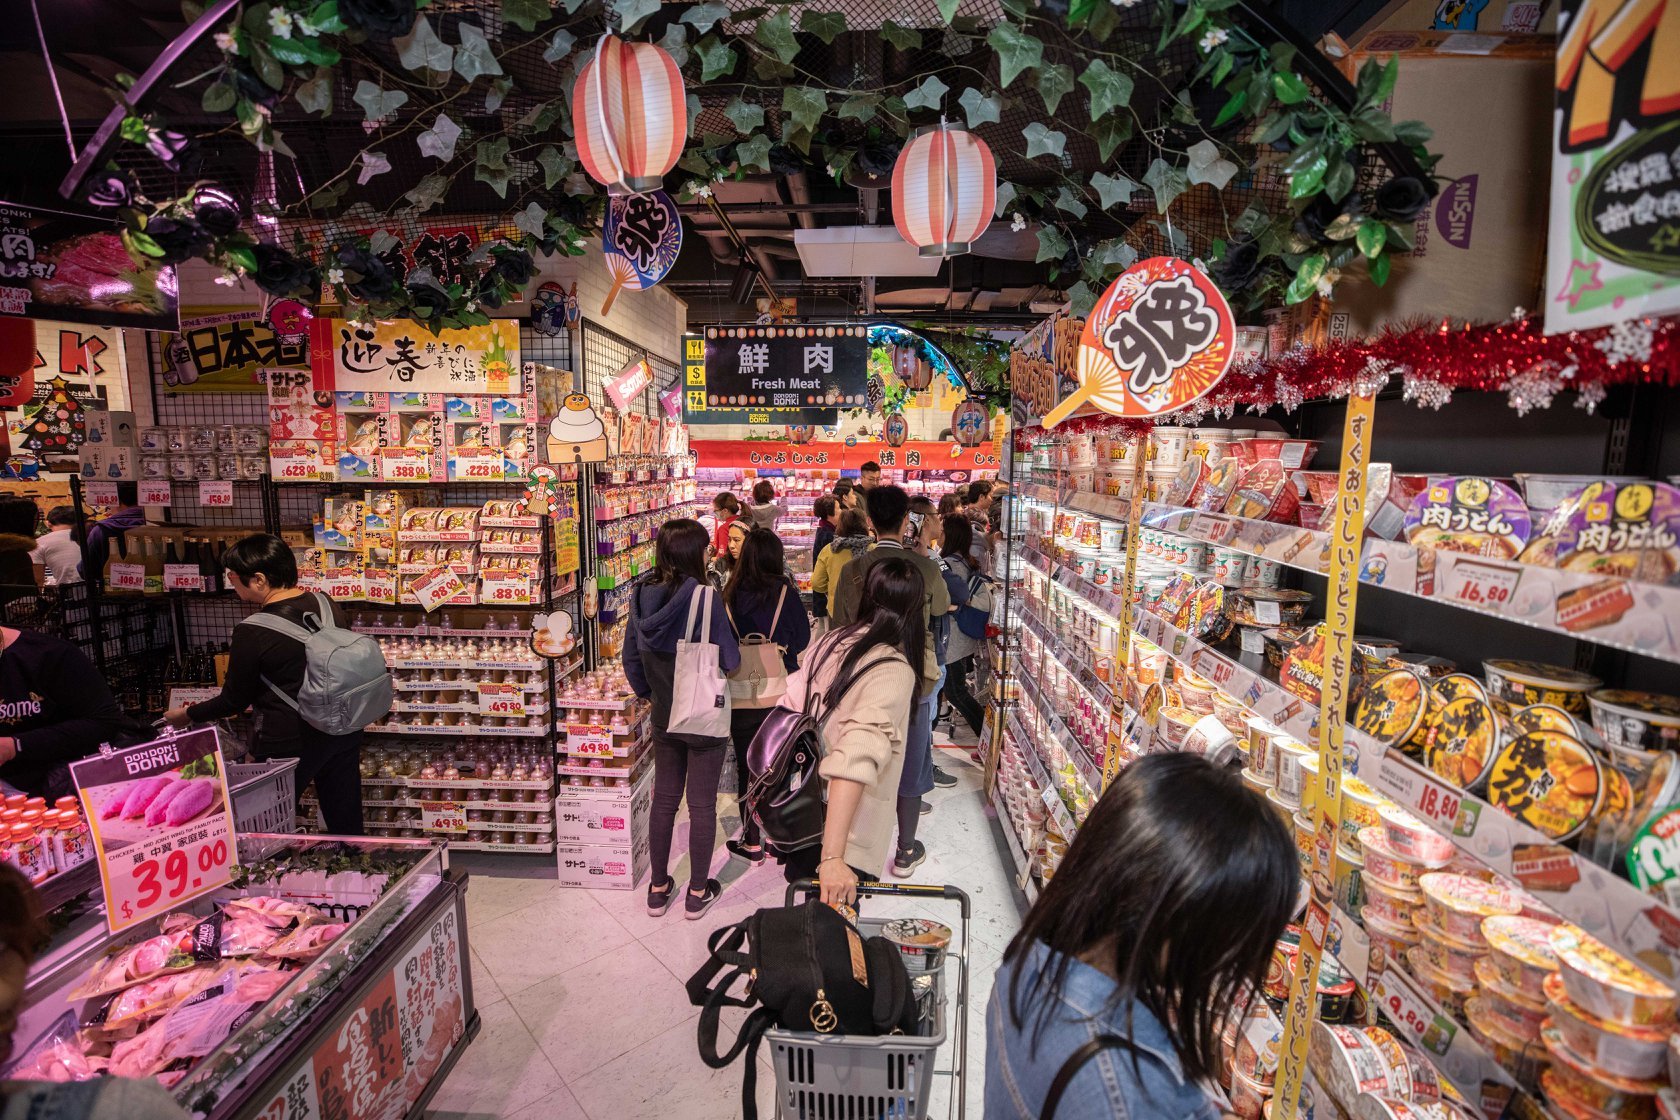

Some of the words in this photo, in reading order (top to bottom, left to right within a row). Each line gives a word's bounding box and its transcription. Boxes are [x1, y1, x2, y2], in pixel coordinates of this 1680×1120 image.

[1450, 182, 1472, 242] NISSIN
[0, 226, 30, 236] ATS!
[33, 330, 107, 375] K
[341, 329, 432, 382] 迎春
[425, 342, 466, 356] 新年の
[434, 356, 474, 369] 喜びに
[737, 343, 834, 375] 鮮肉
[752, 378, 786, 390] Fresh
[789, 378, 821, 390] Meat
[879, 450, 921, 466] 焼肉
[974, 452, 1001, 465] しゃ
[1421, 504, 1514, 535] 肉うどん
[1576, 523, 1677, 552] 肉うどん
[492, 588, 526, 599] $88.00
[0, 700, 41, 719] some
[489, 702, 521, 712] $49.80
[577, 743, 610, 753] $49.80
[127, 749, 180, 775] DONKI
[432, 818, 464, 828] $49.80
[563, 813, 580, 822] サト
[109, 849, 135, 861] CHICKEN
[155, 837, 170, 846] JOINT
[171, 831, 185, 841] WING
[212, 816, 225, 824] PACK
[565, 860, 586, 868] サトウ
[121, 840, 227, 919] $39.00
